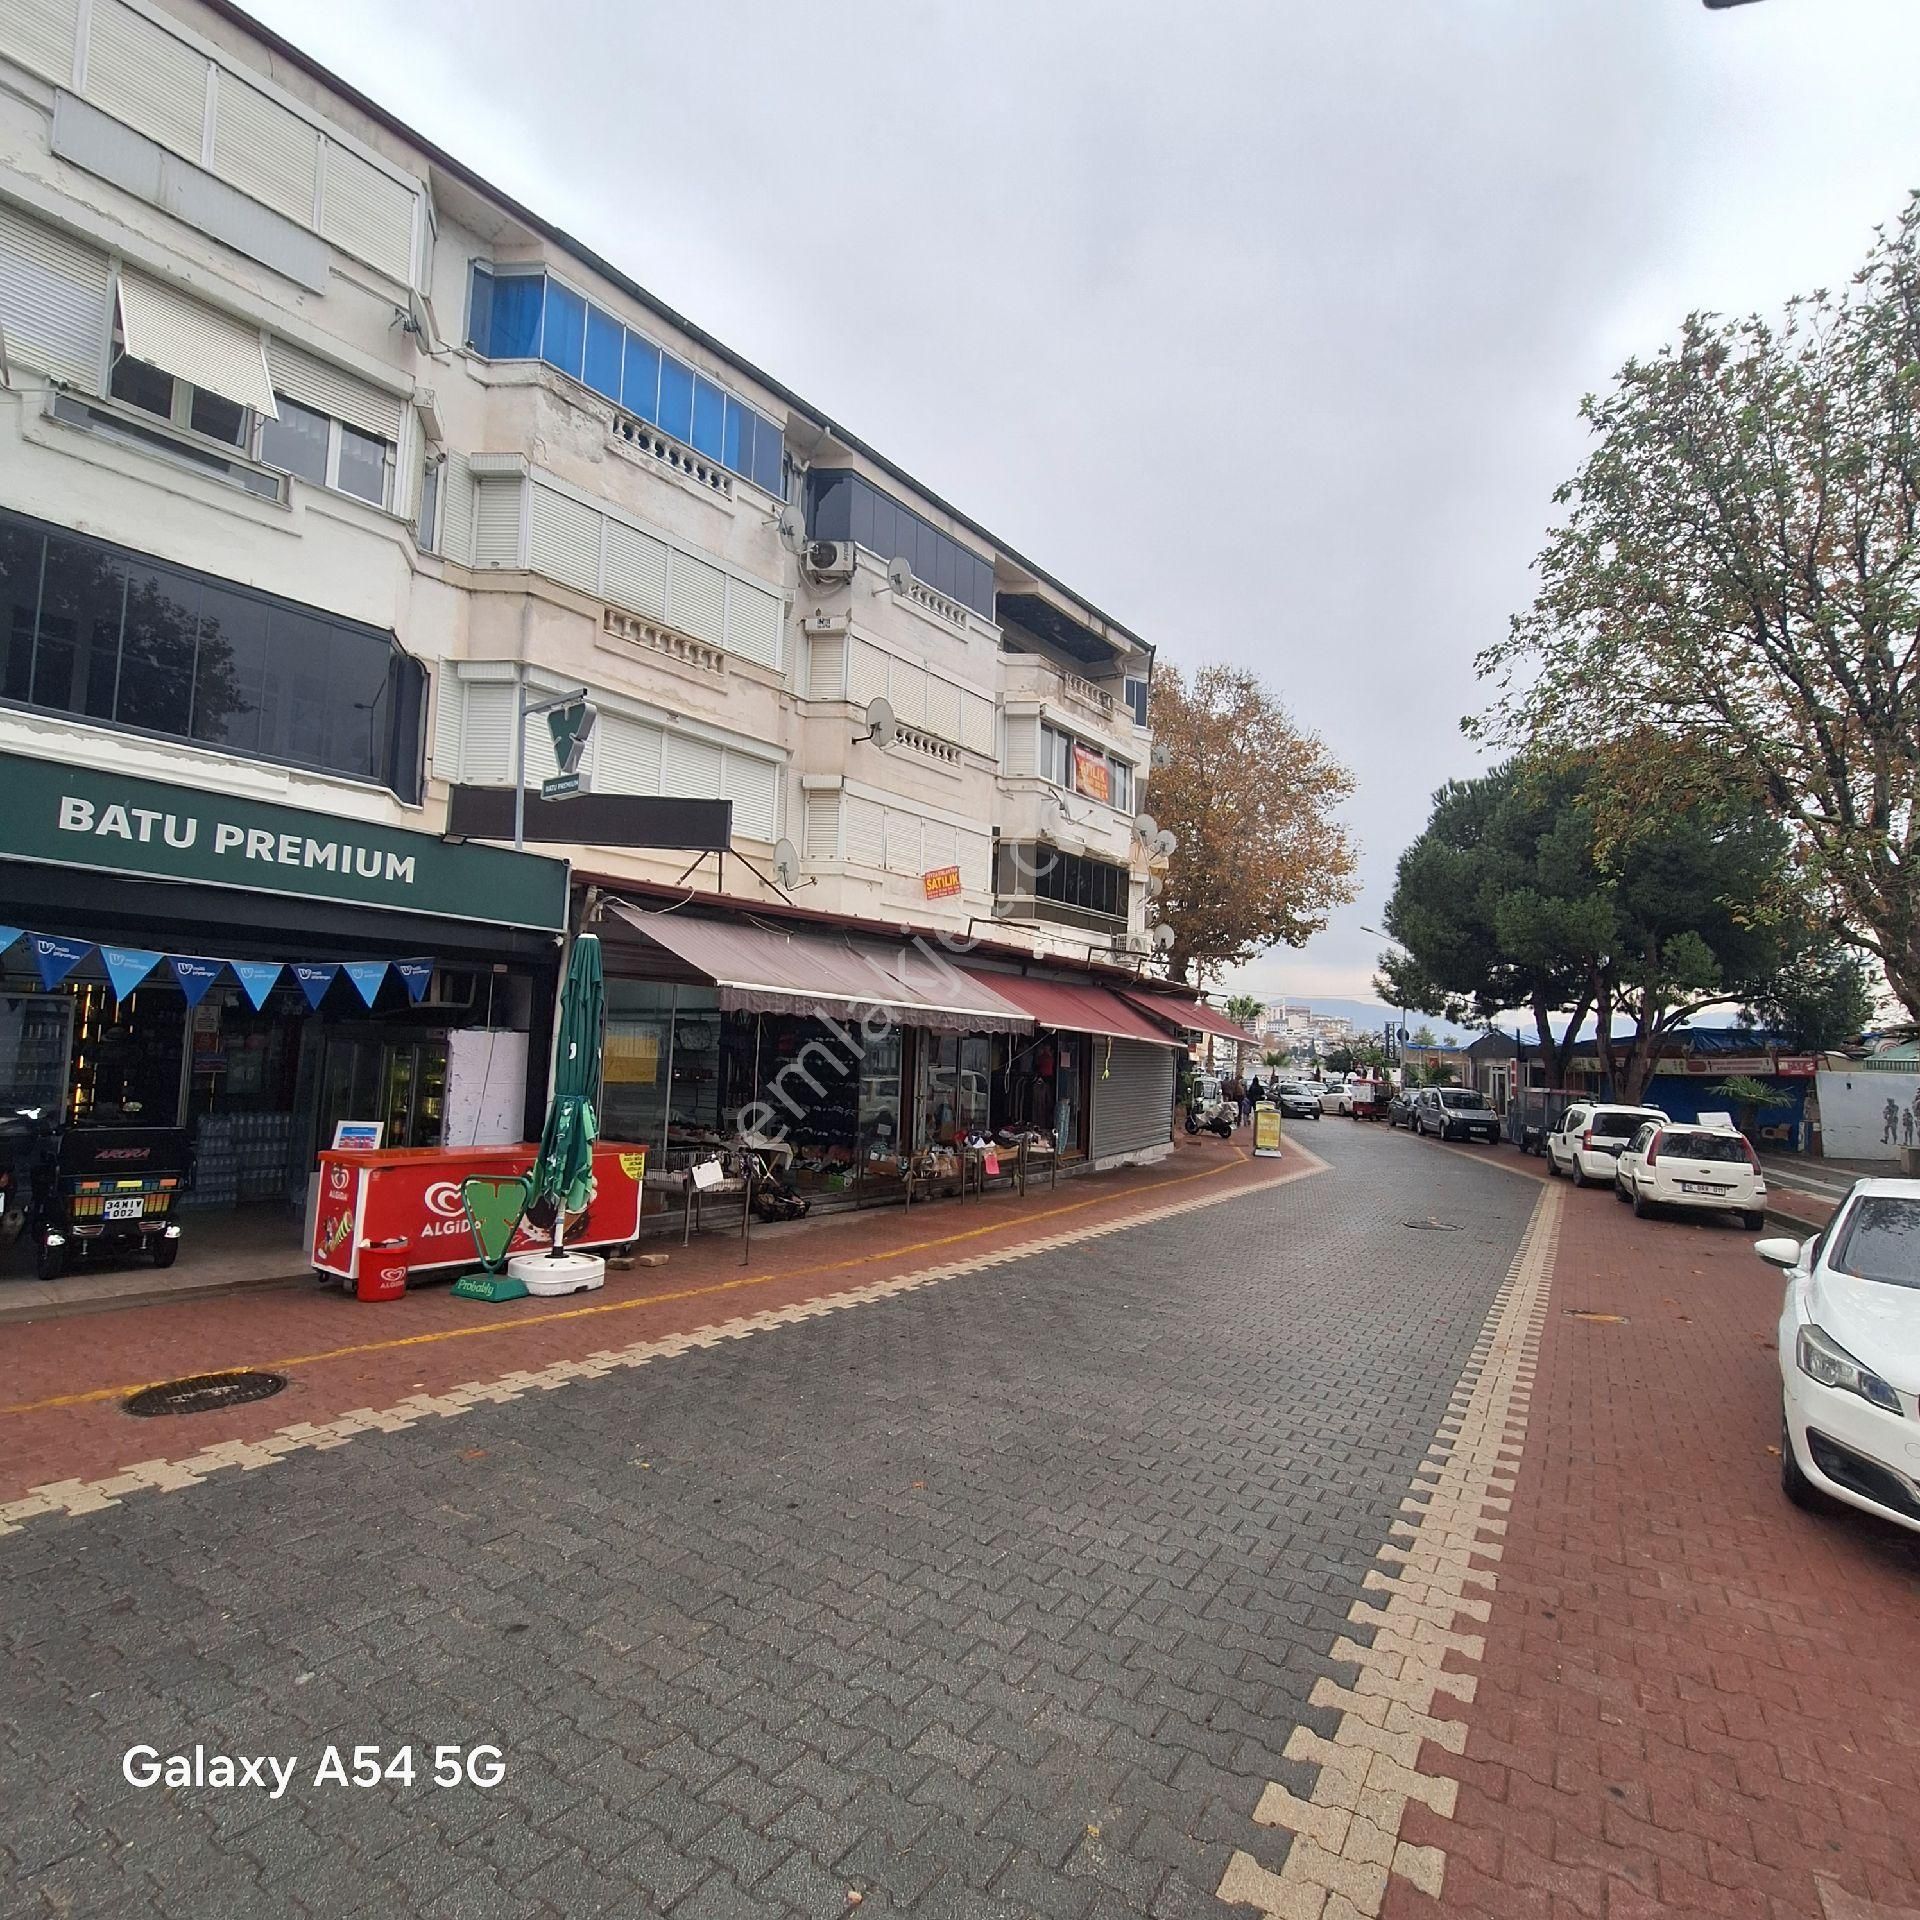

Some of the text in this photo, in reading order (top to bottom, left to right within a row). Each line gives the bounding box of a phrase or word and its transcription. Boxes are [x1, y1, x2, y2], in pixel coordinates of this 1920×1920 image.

[58, 795, 416, 884] BATU PREMIUM
[926, 873, 960, 891] SATILIK
